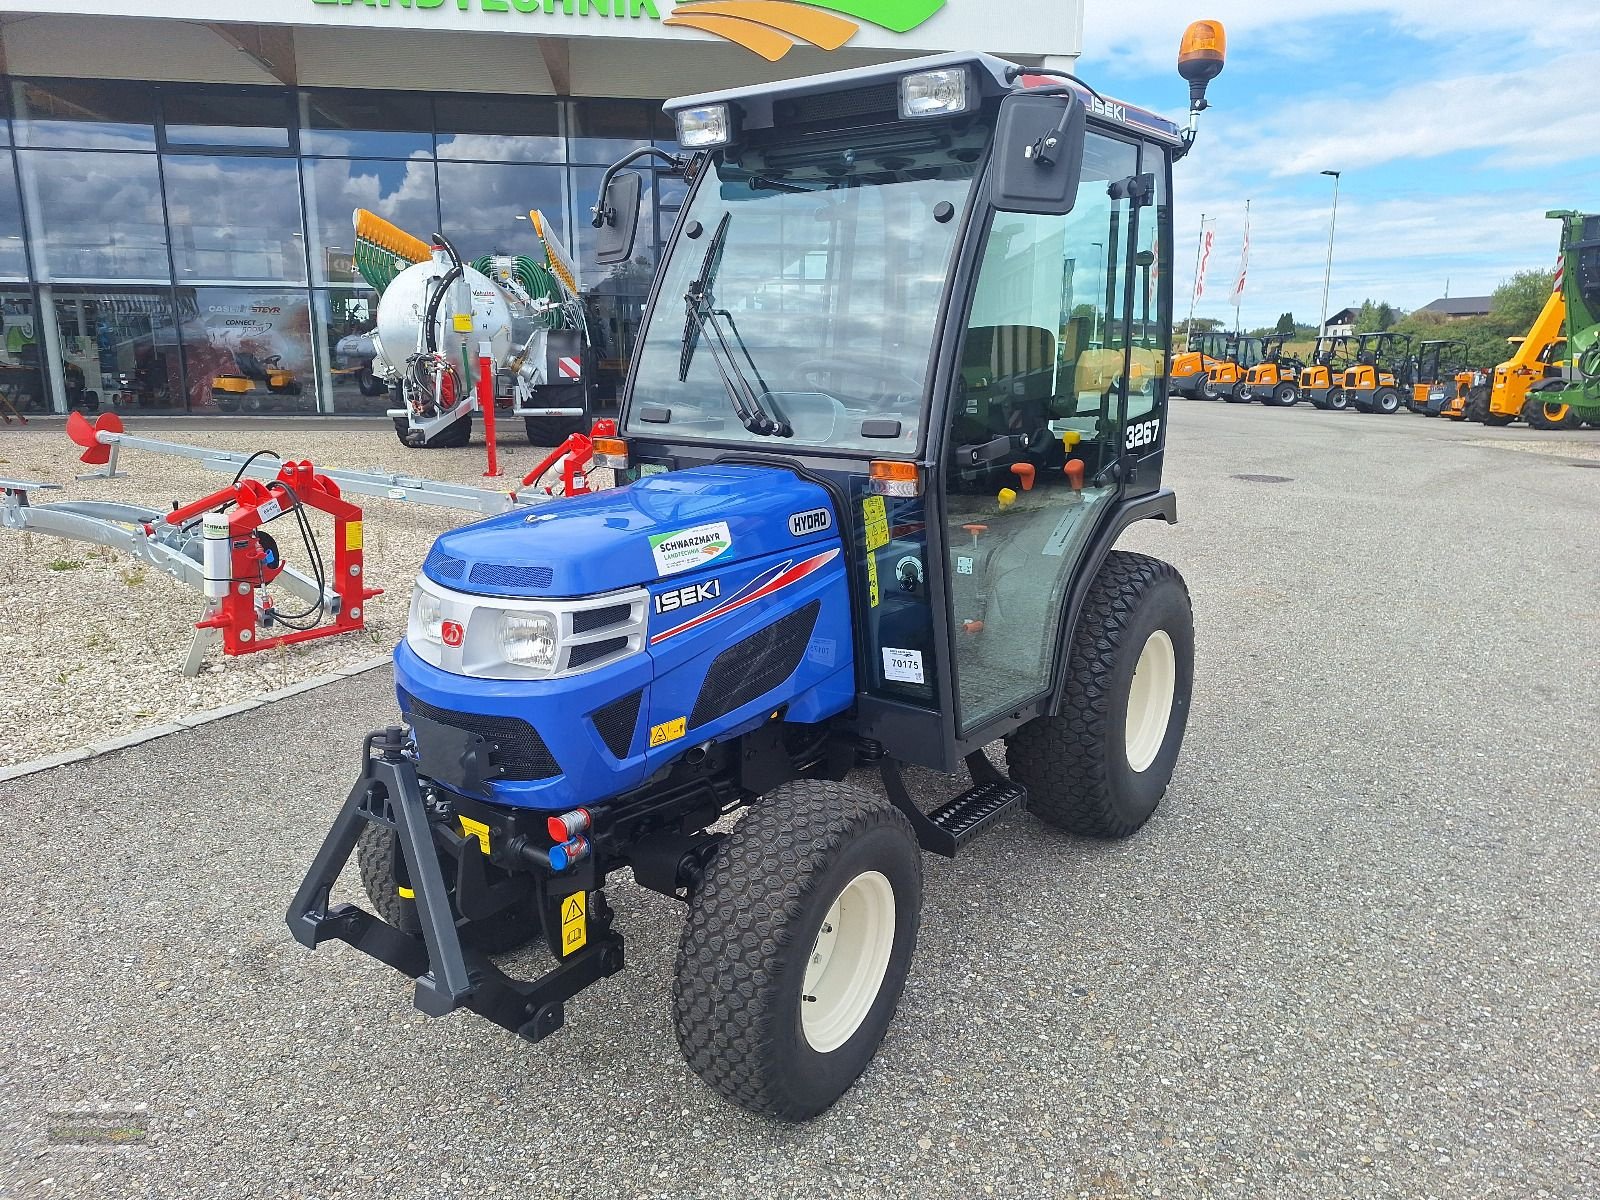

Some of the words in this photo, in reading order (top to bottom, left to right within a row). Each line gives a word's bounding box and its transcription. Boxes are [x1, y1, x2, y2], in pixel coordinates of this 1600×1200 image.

[1090, 95, 1126, 122] ISEKI
[249, 306, 281, 314] STEYR
[1125, 418, 1160, 450] 3267
[793, 511, 827, 533] HYDRO
[659, 532, 721, 553] SCHWARZMAYR
[654, 578, 721, 615] ISEKI
[891, 658, 919, 670] 70175
